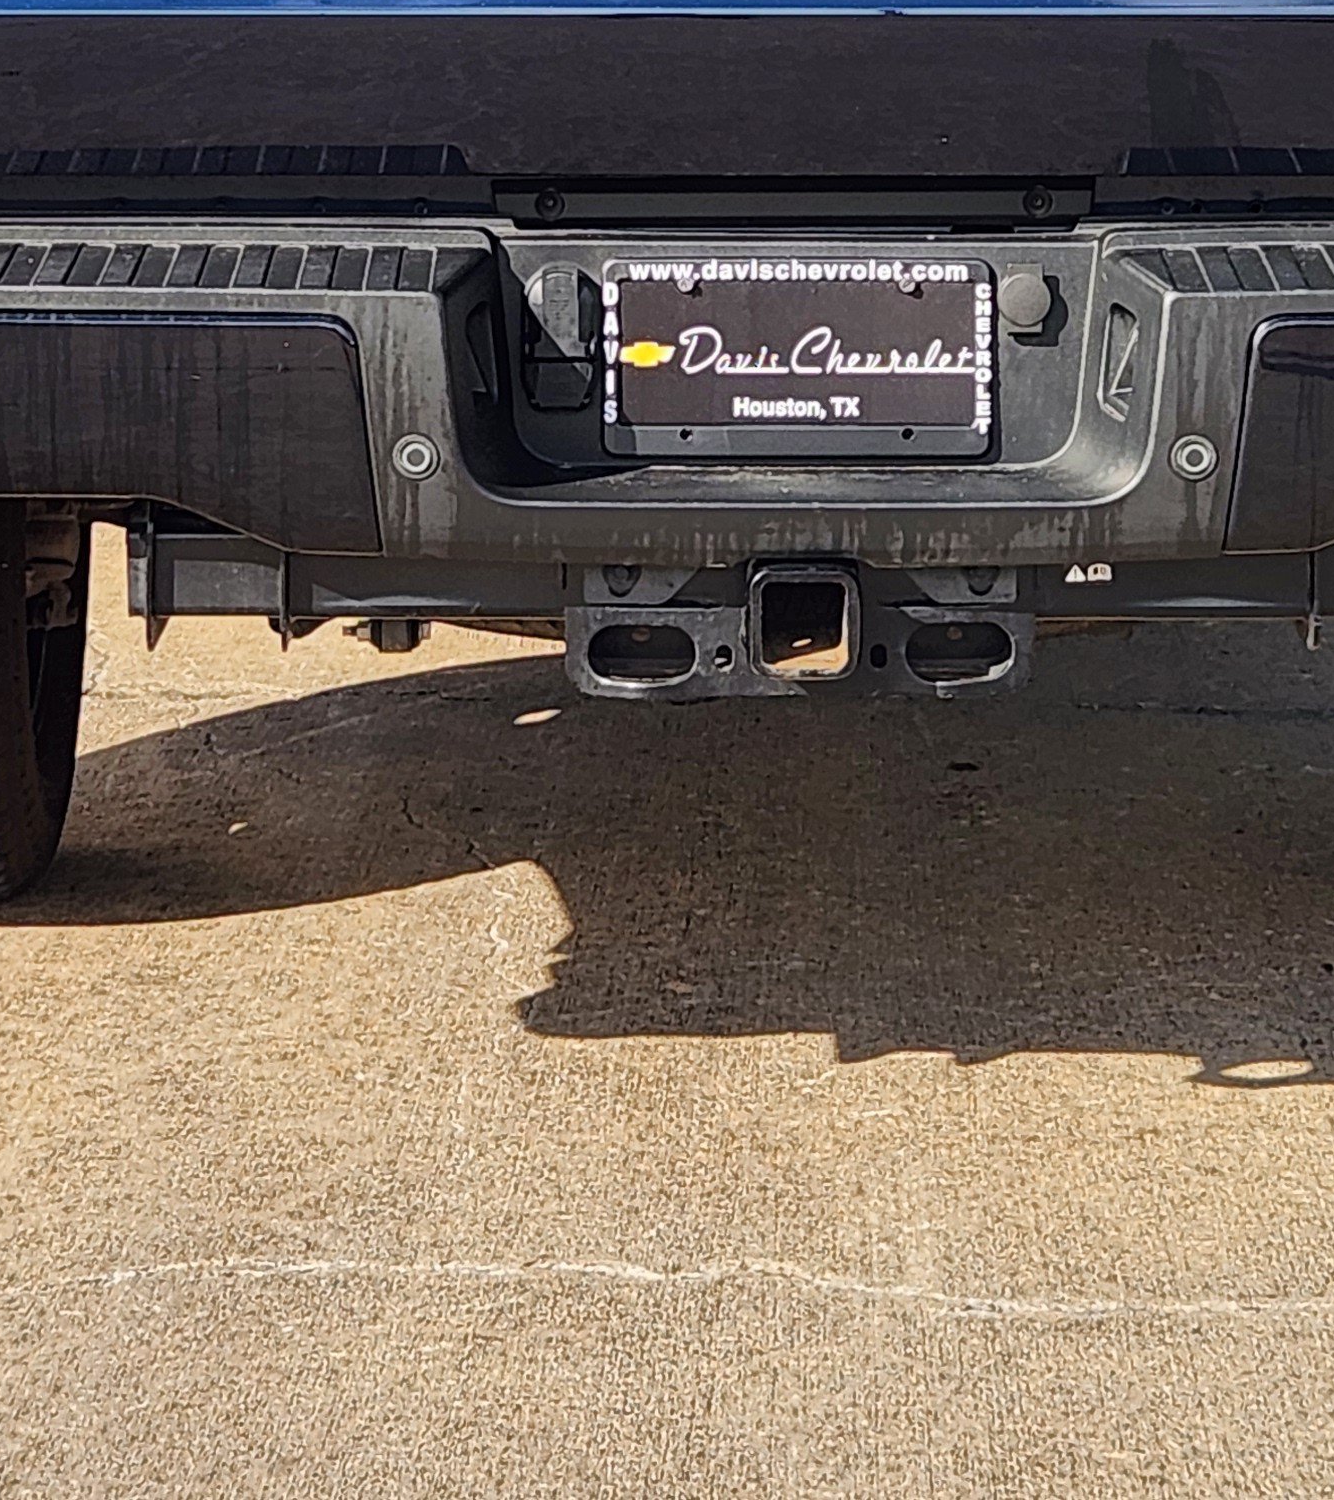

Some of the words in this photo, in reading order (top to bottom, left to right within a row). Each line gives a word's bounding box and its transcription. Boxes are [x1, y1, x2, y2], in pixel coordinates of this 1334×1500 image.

[629, 259, 968, 282] www.davischevrolet.com
[602, 282, 620, 424] DAVIS
[678, 326, 789, 376] Davis
[790, 326, 975, 375] Chevrolet
[971, 283, 992, 435] CHEVROLET
[732, 396, 827, 421] Houston,
[830, 396, 860, 418] TX
